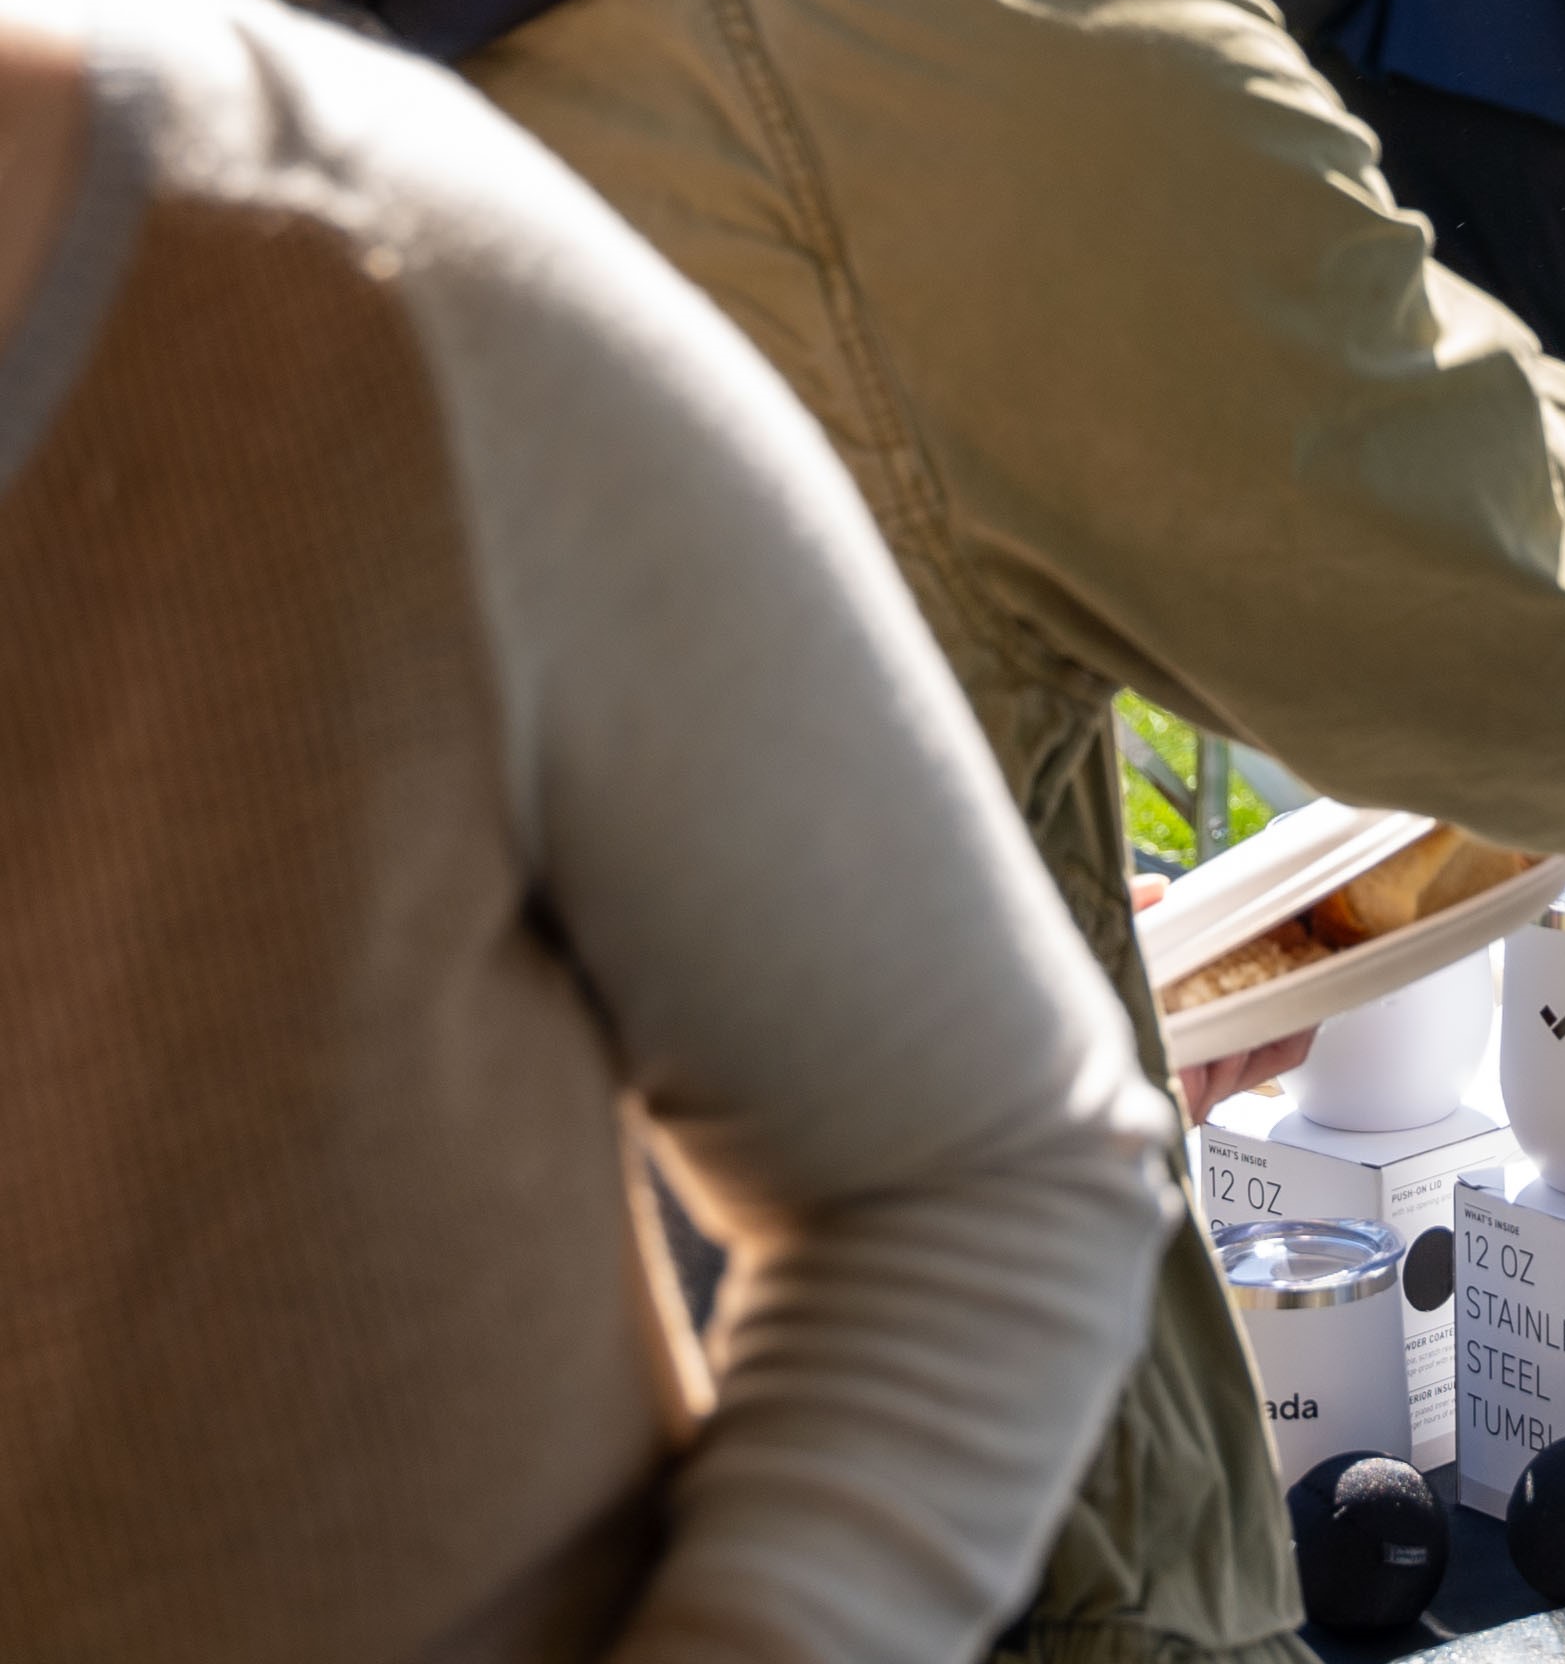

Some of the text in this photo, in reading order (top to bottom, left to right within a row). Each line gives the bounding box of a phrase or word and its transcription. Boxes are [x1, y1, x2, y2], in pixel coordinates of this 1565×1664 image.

[1208, 1144, 1268, 1169] WHAT'S INSIDE
[1208, 1165, 1283, 1216] 12 OZ
[1464, 1208, 1520, 1236] WHAT'S INSIDE
[1464, 1230, 1536, 1286] 12 OZ
[1429, 1327, 1454, 1345] COATE
[1466, 1339, 1551, 1402] STEEL
